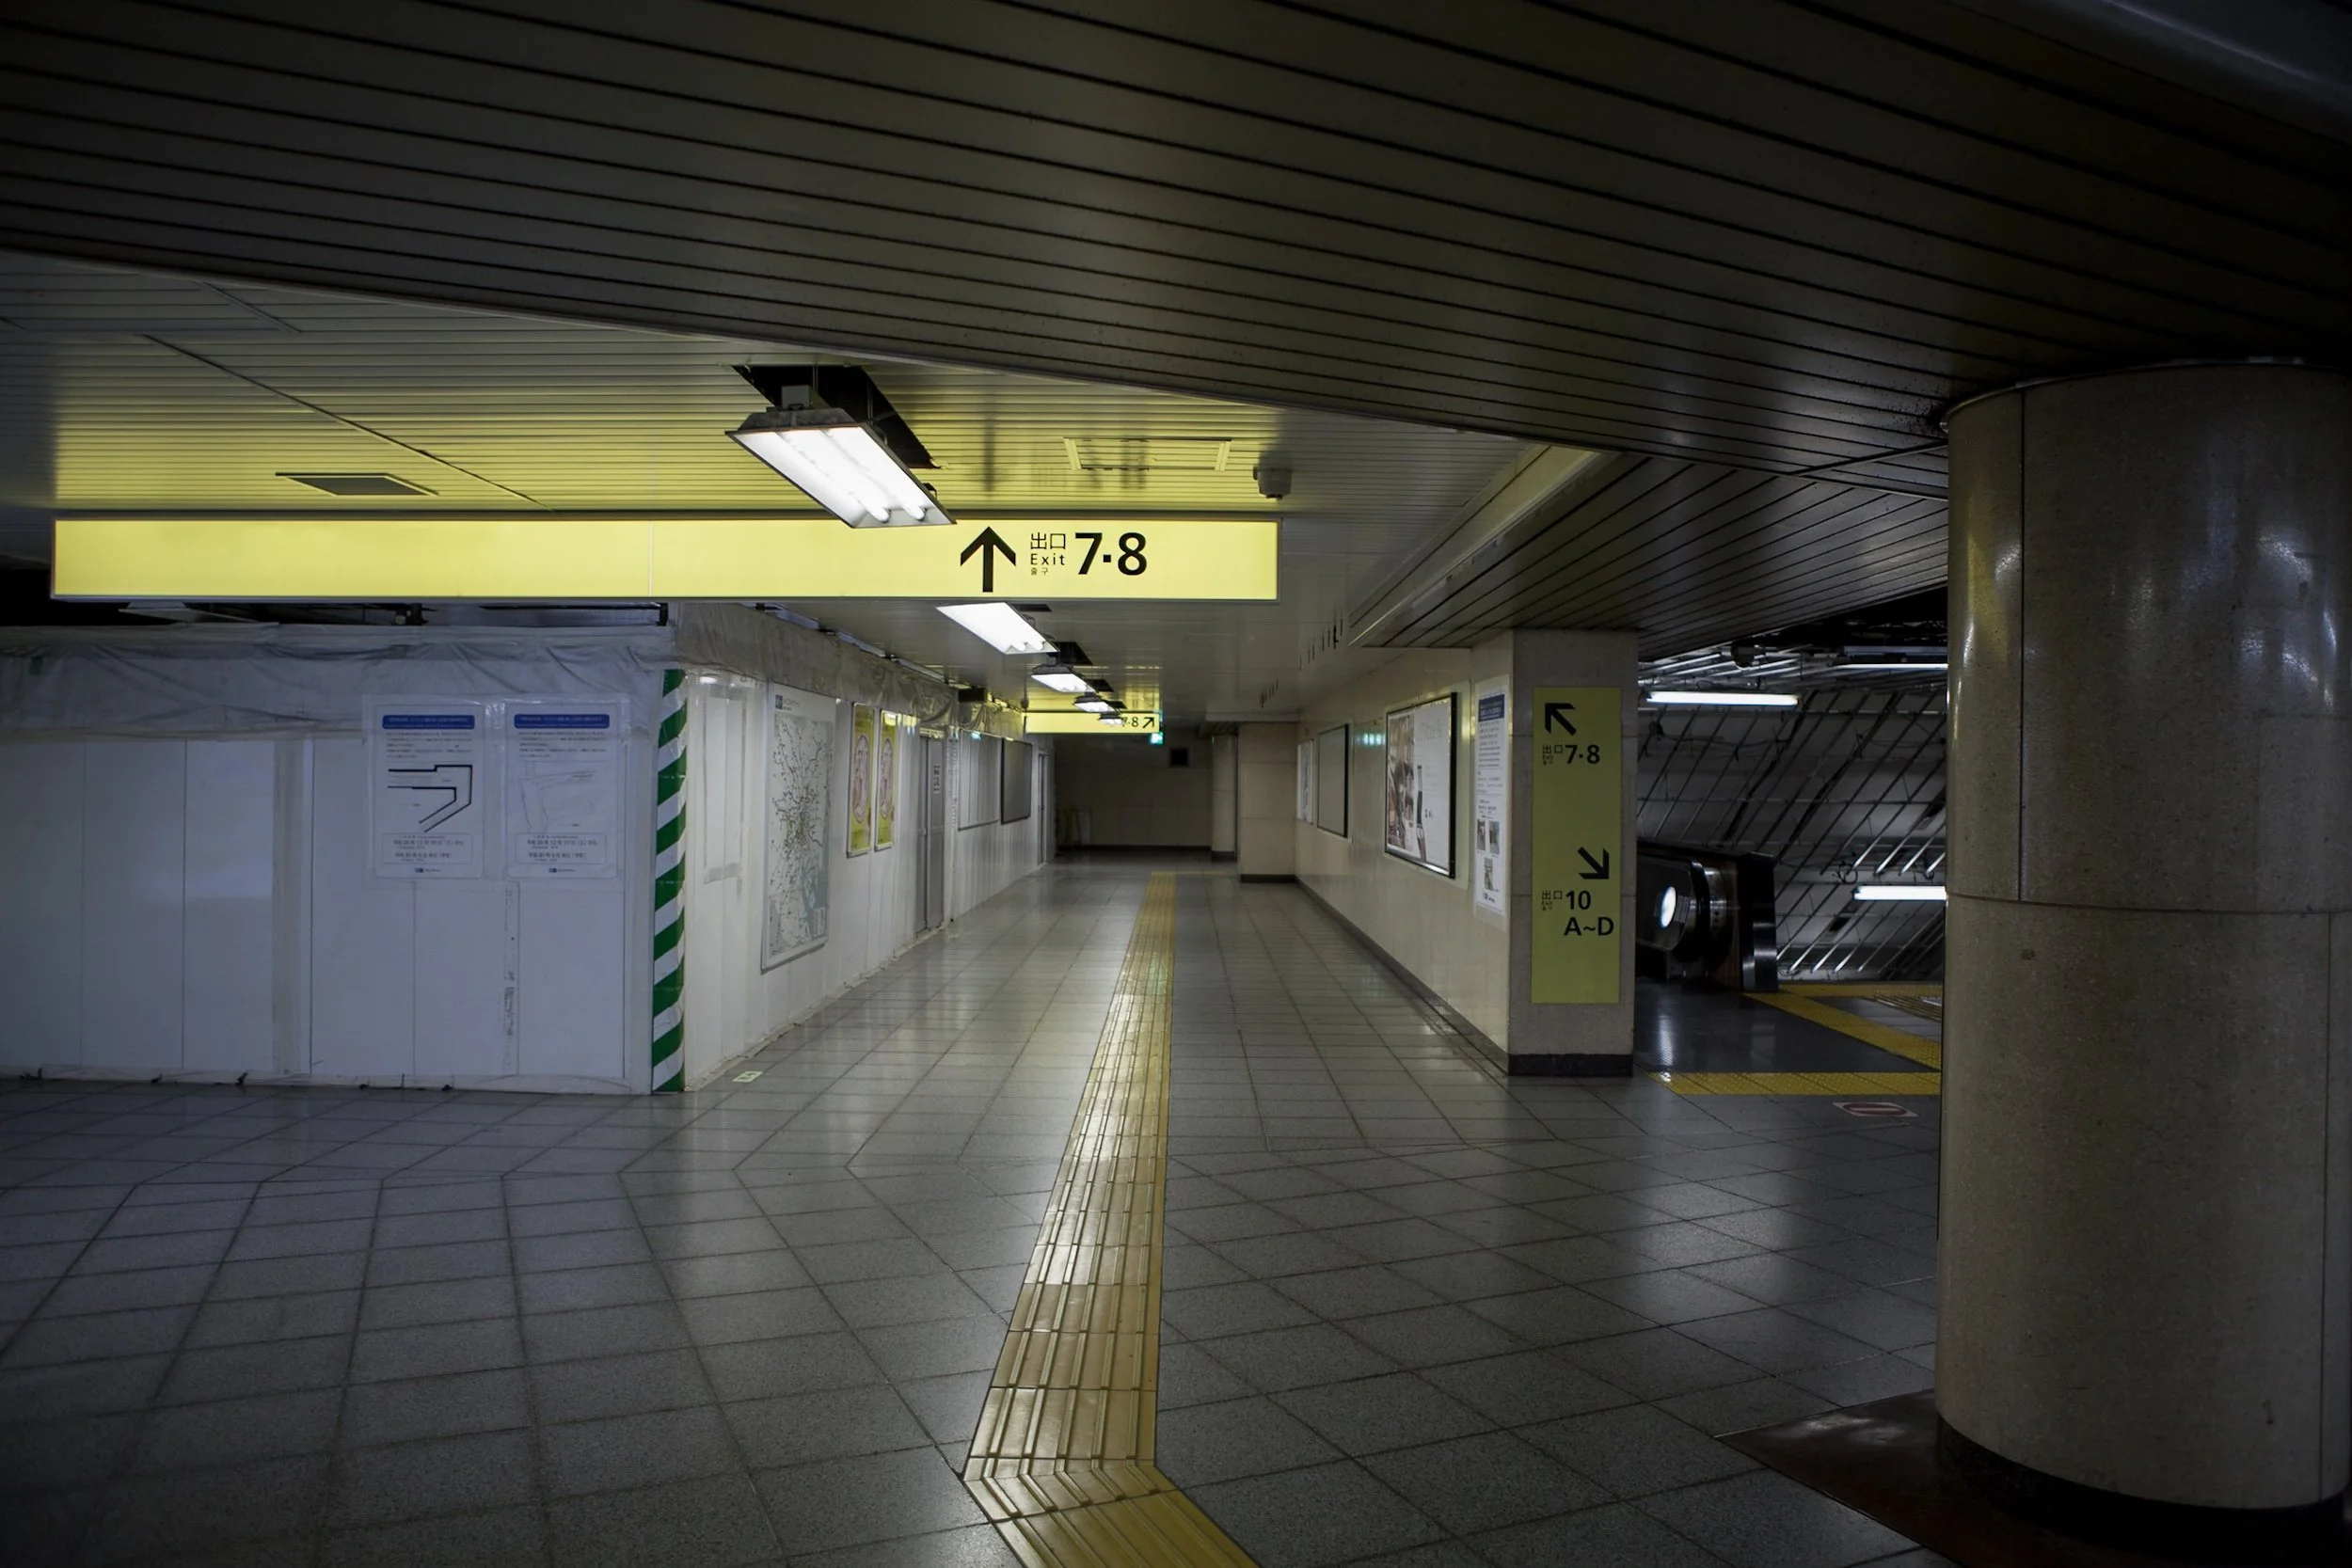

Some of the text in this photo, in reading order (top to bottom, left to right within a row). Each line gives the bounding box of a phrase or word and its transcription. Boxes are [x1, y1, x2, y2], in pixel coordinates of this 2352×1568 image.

[1030, 531, 1067, 550] 出口
[1030, 552, 1066, 566] Exit
[1542, 744, 1564, 755] 出口
[1541, 890, 1564, 901] 出口
[1565, 890, 1592, 911] 10
